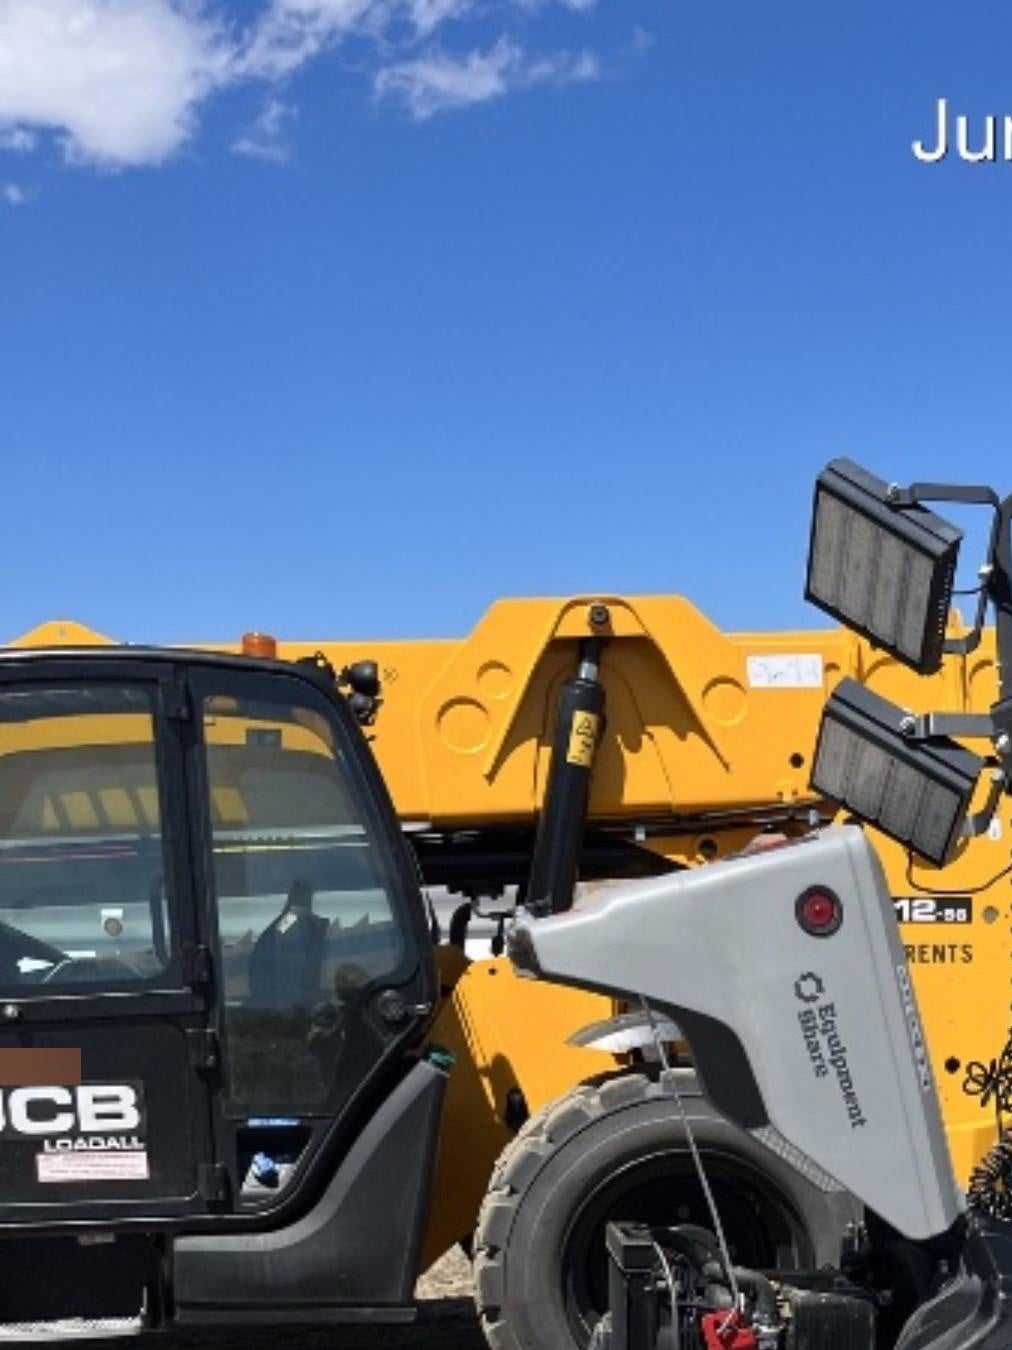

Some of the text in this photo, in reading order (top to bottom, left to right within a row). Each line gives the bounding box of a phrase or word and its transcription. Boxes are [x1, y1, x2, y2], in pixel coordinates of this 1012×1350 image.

[798, 1009, 829, 1078] Share
[818, 1001, 868, 1129] Equipment
[0, 1085, 142, 1135] CB
[43, 1135, 146, 1153] LOADALL
